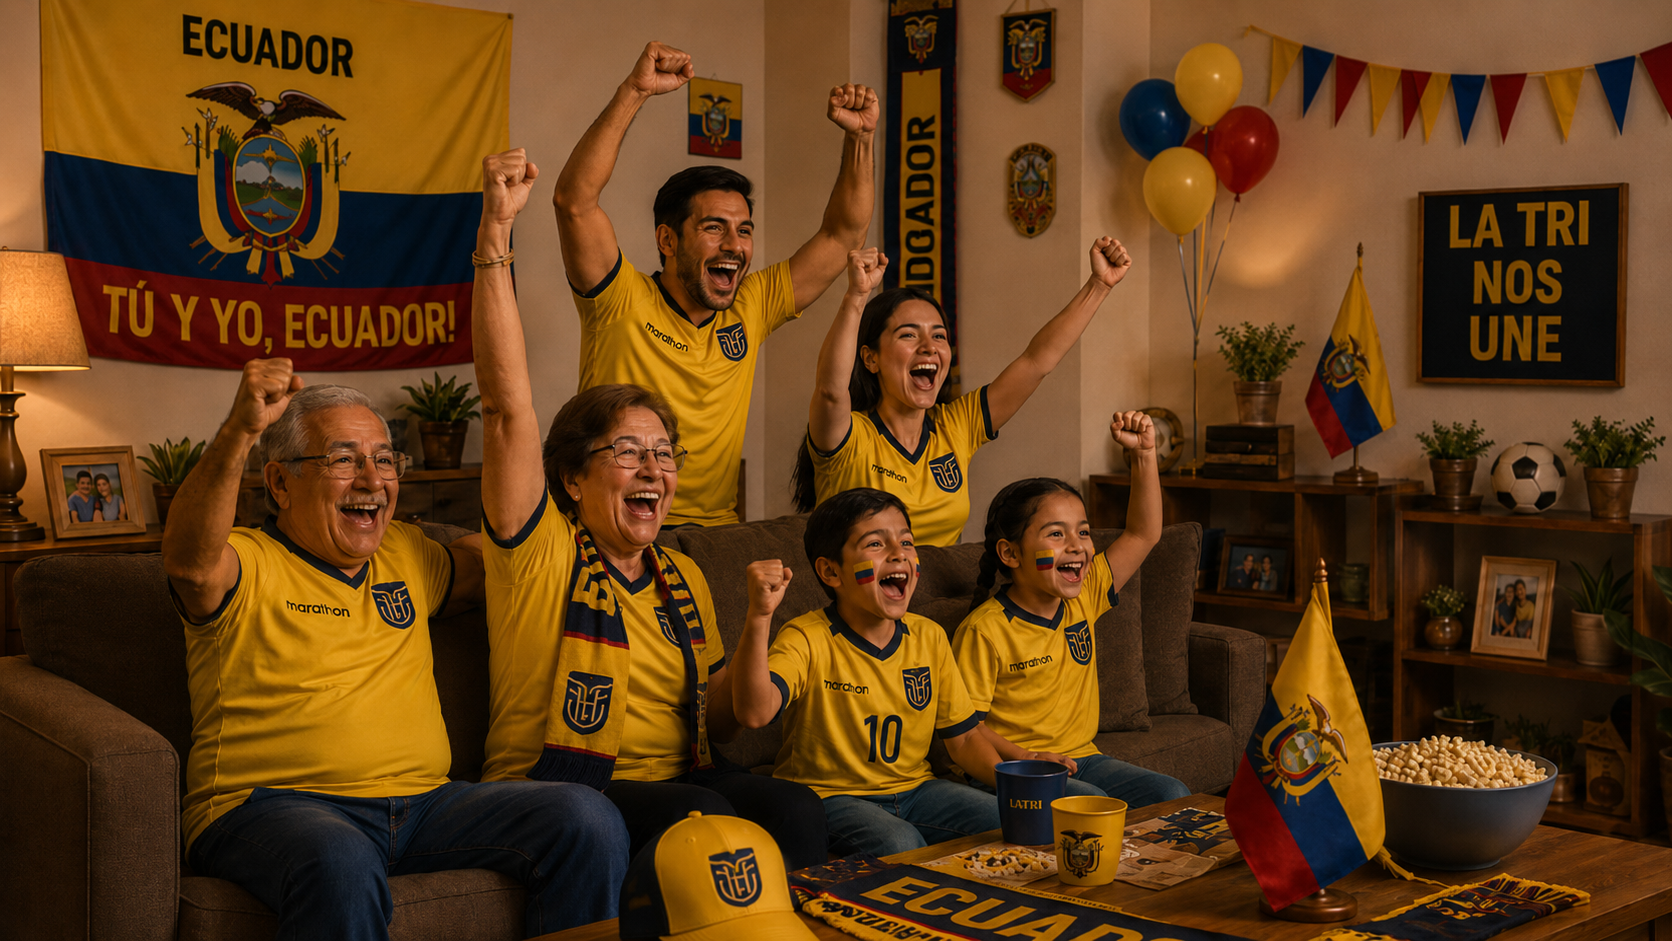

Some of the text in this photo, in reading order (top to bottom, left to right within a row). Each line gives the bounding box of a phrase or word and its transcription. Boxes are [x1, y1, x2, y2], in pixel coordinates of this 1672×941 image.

[182, 14, 354, 78] ECUADOR
[1449, 200, 1590, 249] LA TRI
[1473, 259, 1563, 304] NOS
[102, 280, 456, 355] TÚ Y YO, ECUADOR!
[645, 322, 689, 352] marathon
[1470, 315, 1562, 362] UNE
[286, 600, 351, 618] marathon
[864, 714, 903, 764] 10
